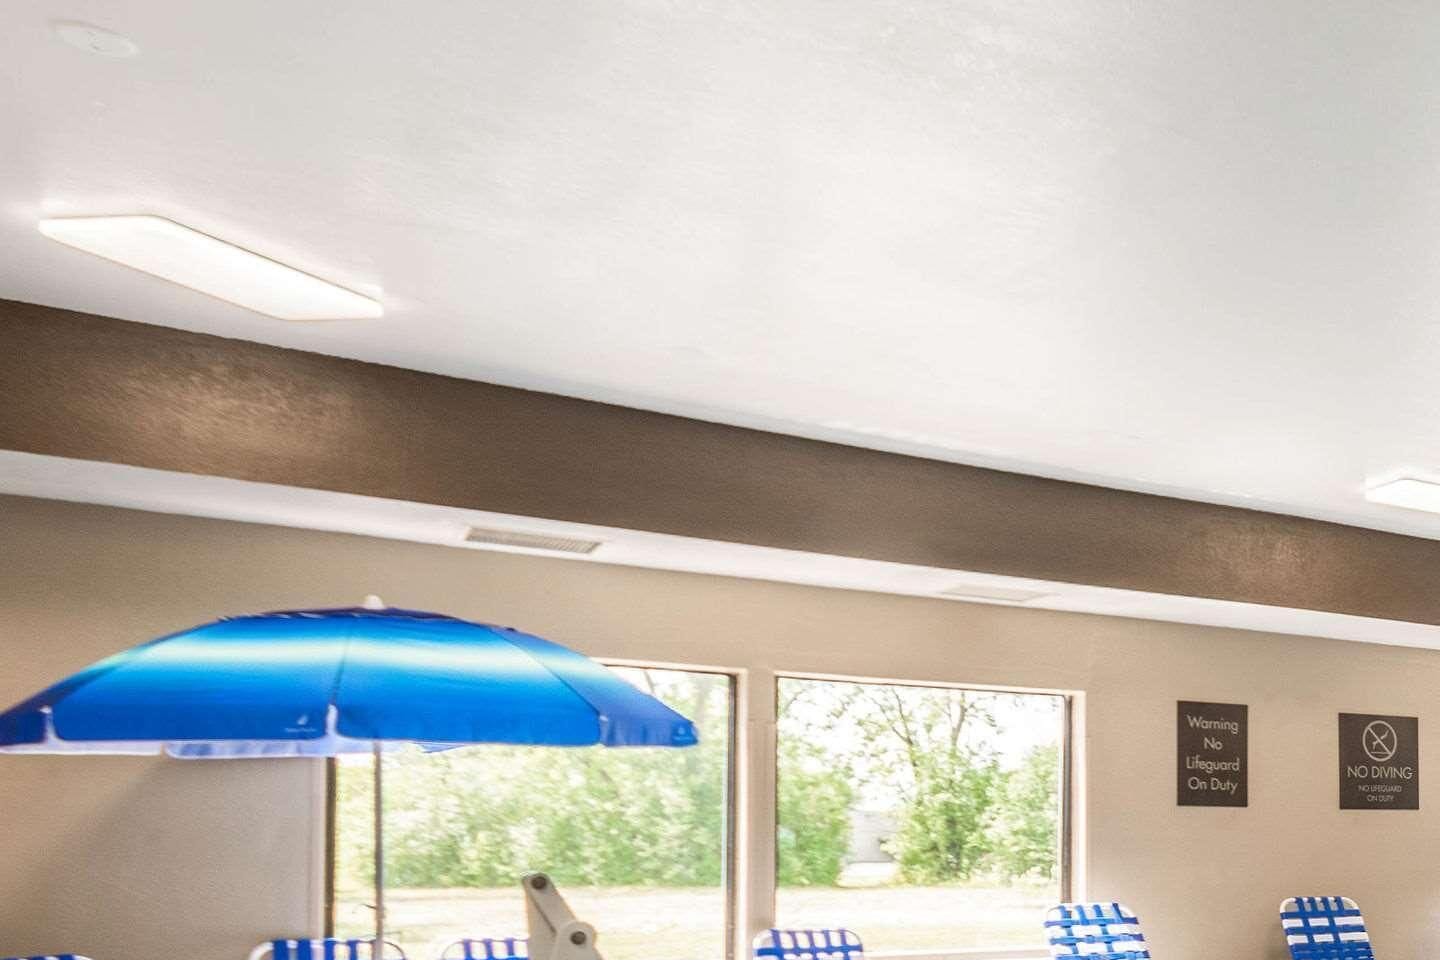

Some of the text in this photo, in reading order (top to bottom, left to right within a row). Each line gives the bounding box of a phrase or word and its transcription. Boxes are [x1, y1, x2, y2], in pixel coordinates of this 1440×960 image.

[1186, 714, 1239, 735] Warning
[1204, 737, 1223, 750] No
[1186, 755, 1240, 774] Lifeguard
[1347, 765, 1413, 780] NO DIVING
[1188, 776, 1238, 795] On Duty
